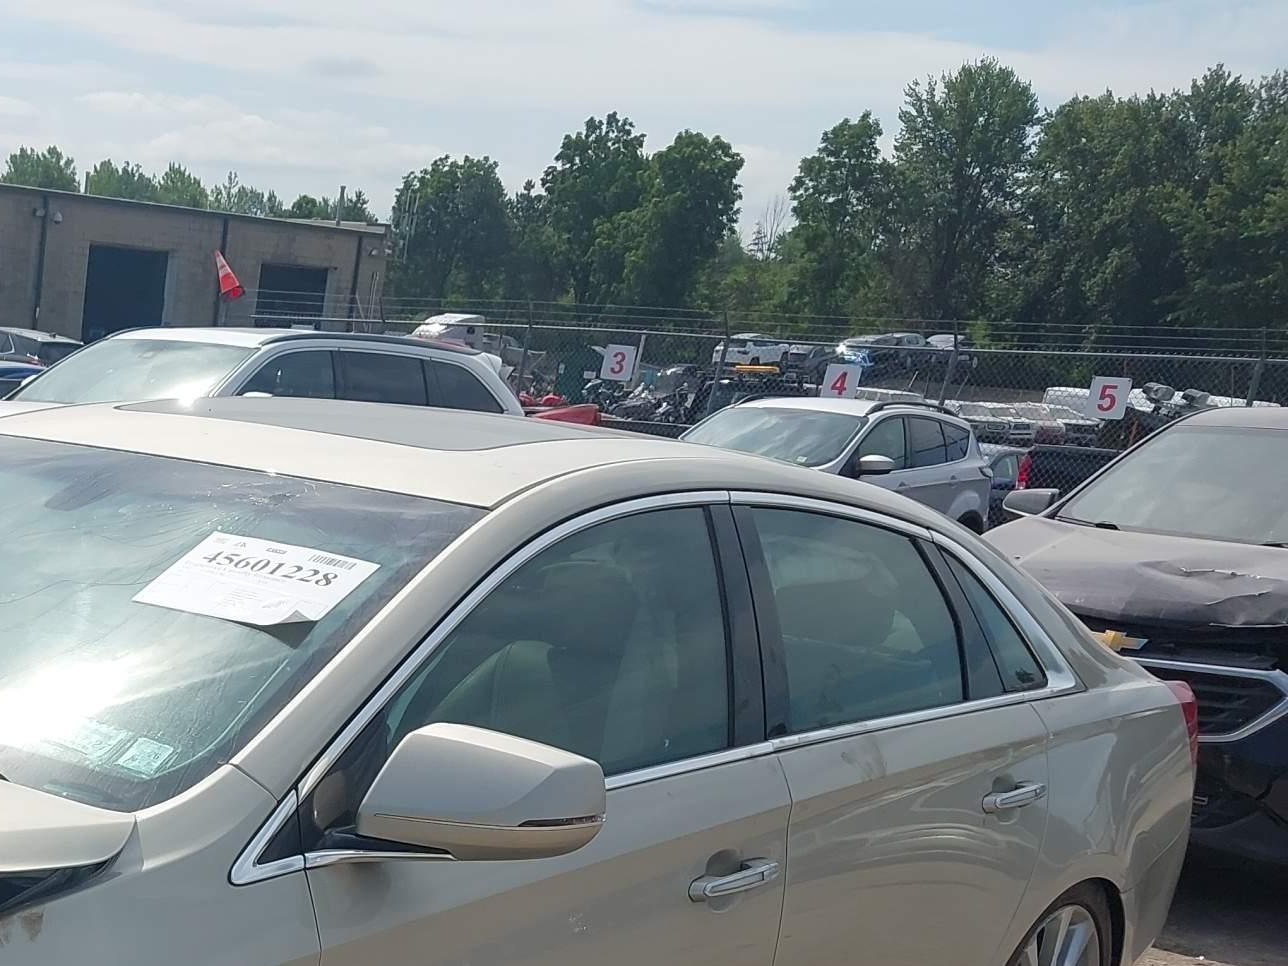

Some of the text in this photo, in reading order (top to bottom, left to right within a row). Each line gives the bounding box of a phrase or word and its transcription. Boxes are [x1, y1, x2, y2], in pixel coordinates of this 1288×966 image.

[610, 351, 626, 375] 3
[830, 371, 848, 396] 4
[1096, 384, 1119, 412] 5
[202, 550, 339, 587] 45601228
